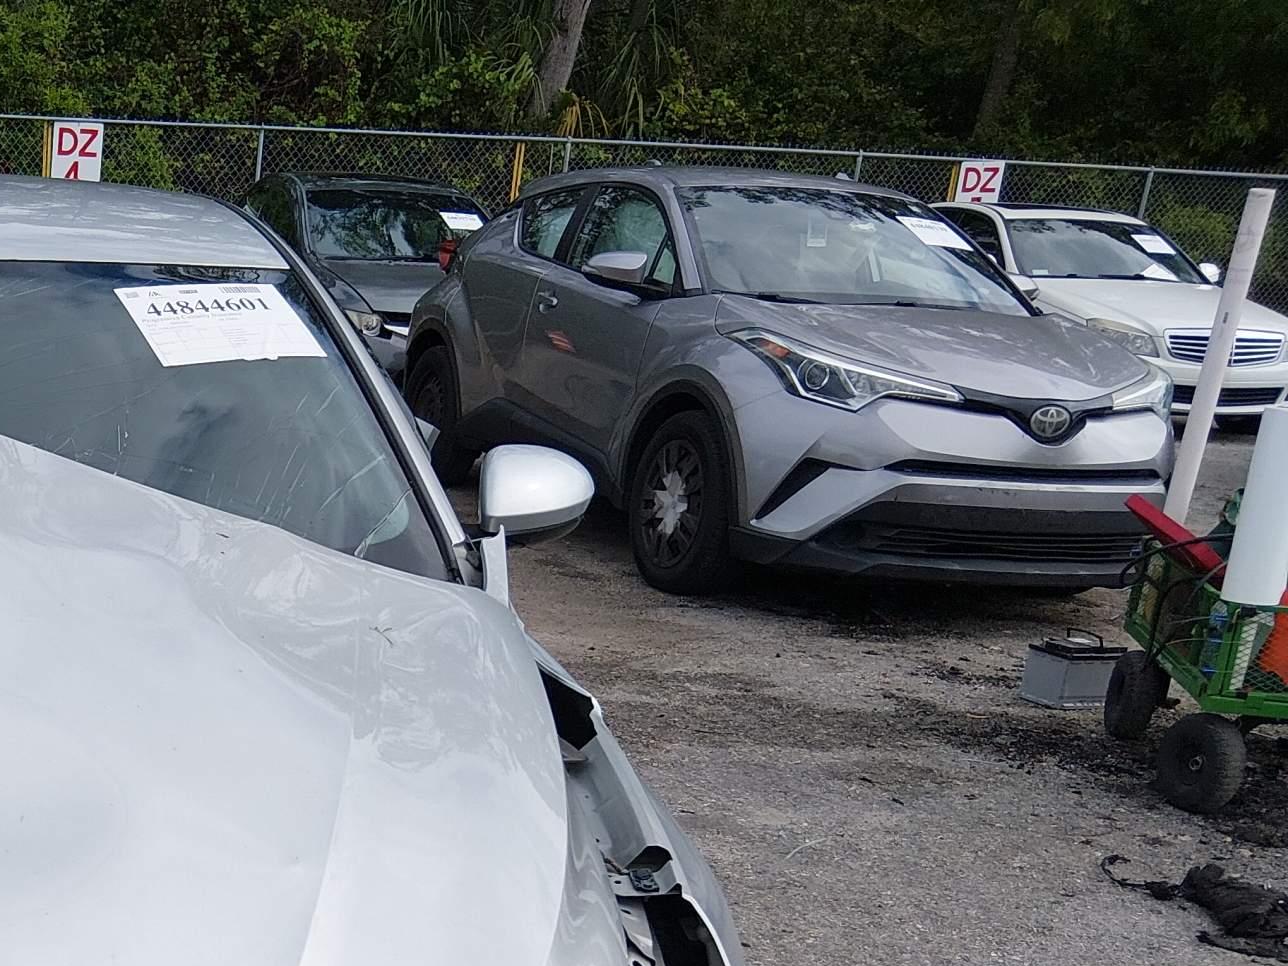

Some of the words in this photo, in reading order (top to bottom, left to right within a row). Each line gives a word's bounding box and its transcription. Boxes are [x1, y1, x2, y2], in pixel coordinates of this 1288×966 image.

[57, 127, 99, 157] DZ
[961, 167, 1000, 193] DZ
[146, 297, 273, 317] 44844601
